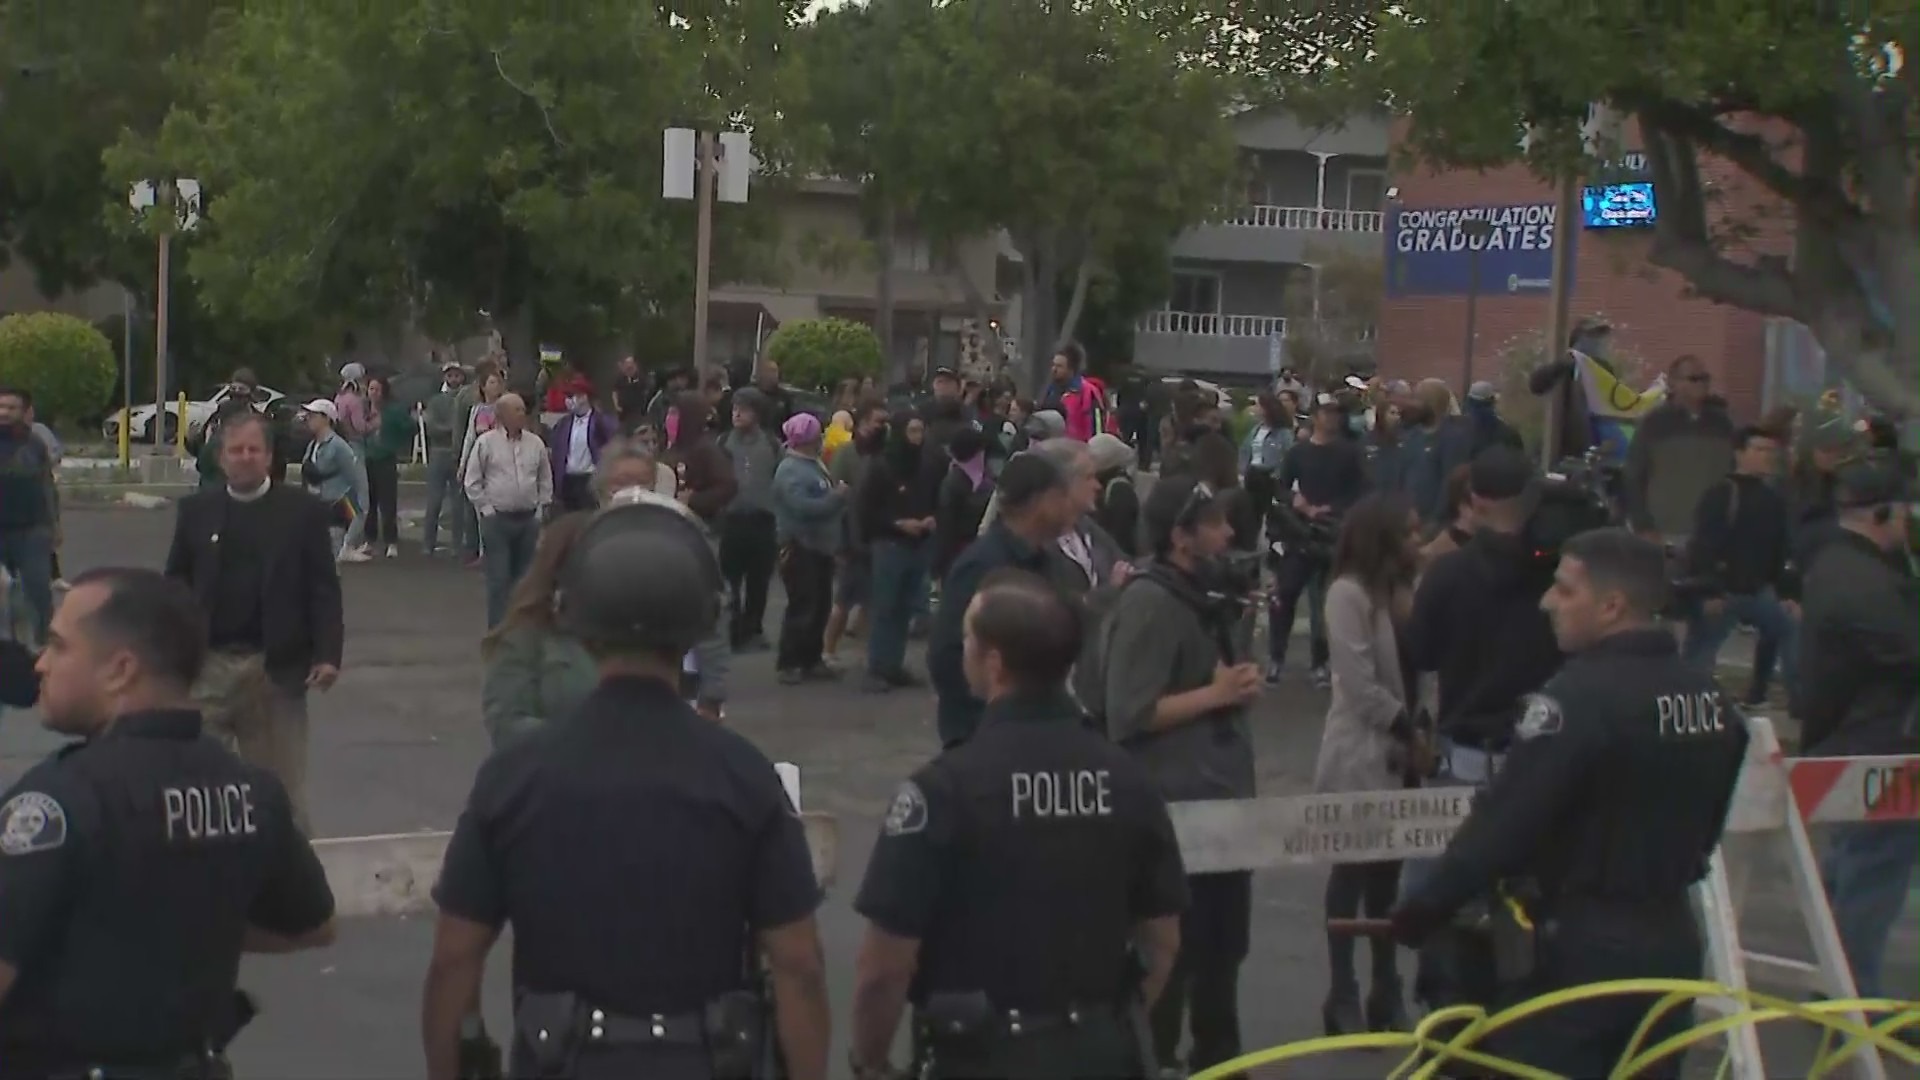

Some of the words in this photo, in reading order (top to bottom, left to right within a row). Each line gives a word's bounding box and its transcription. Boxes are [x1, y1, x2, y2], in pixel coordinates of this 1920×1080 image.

[1397, 225, 1553, 251] GRADUATES
[1656, 691, 1724, 736] POLICE
[163, 784, 256, 839] POLICE
[1011, 770, 1112, 817] POLICE
[1304, 803, 1342, 826] CITY
